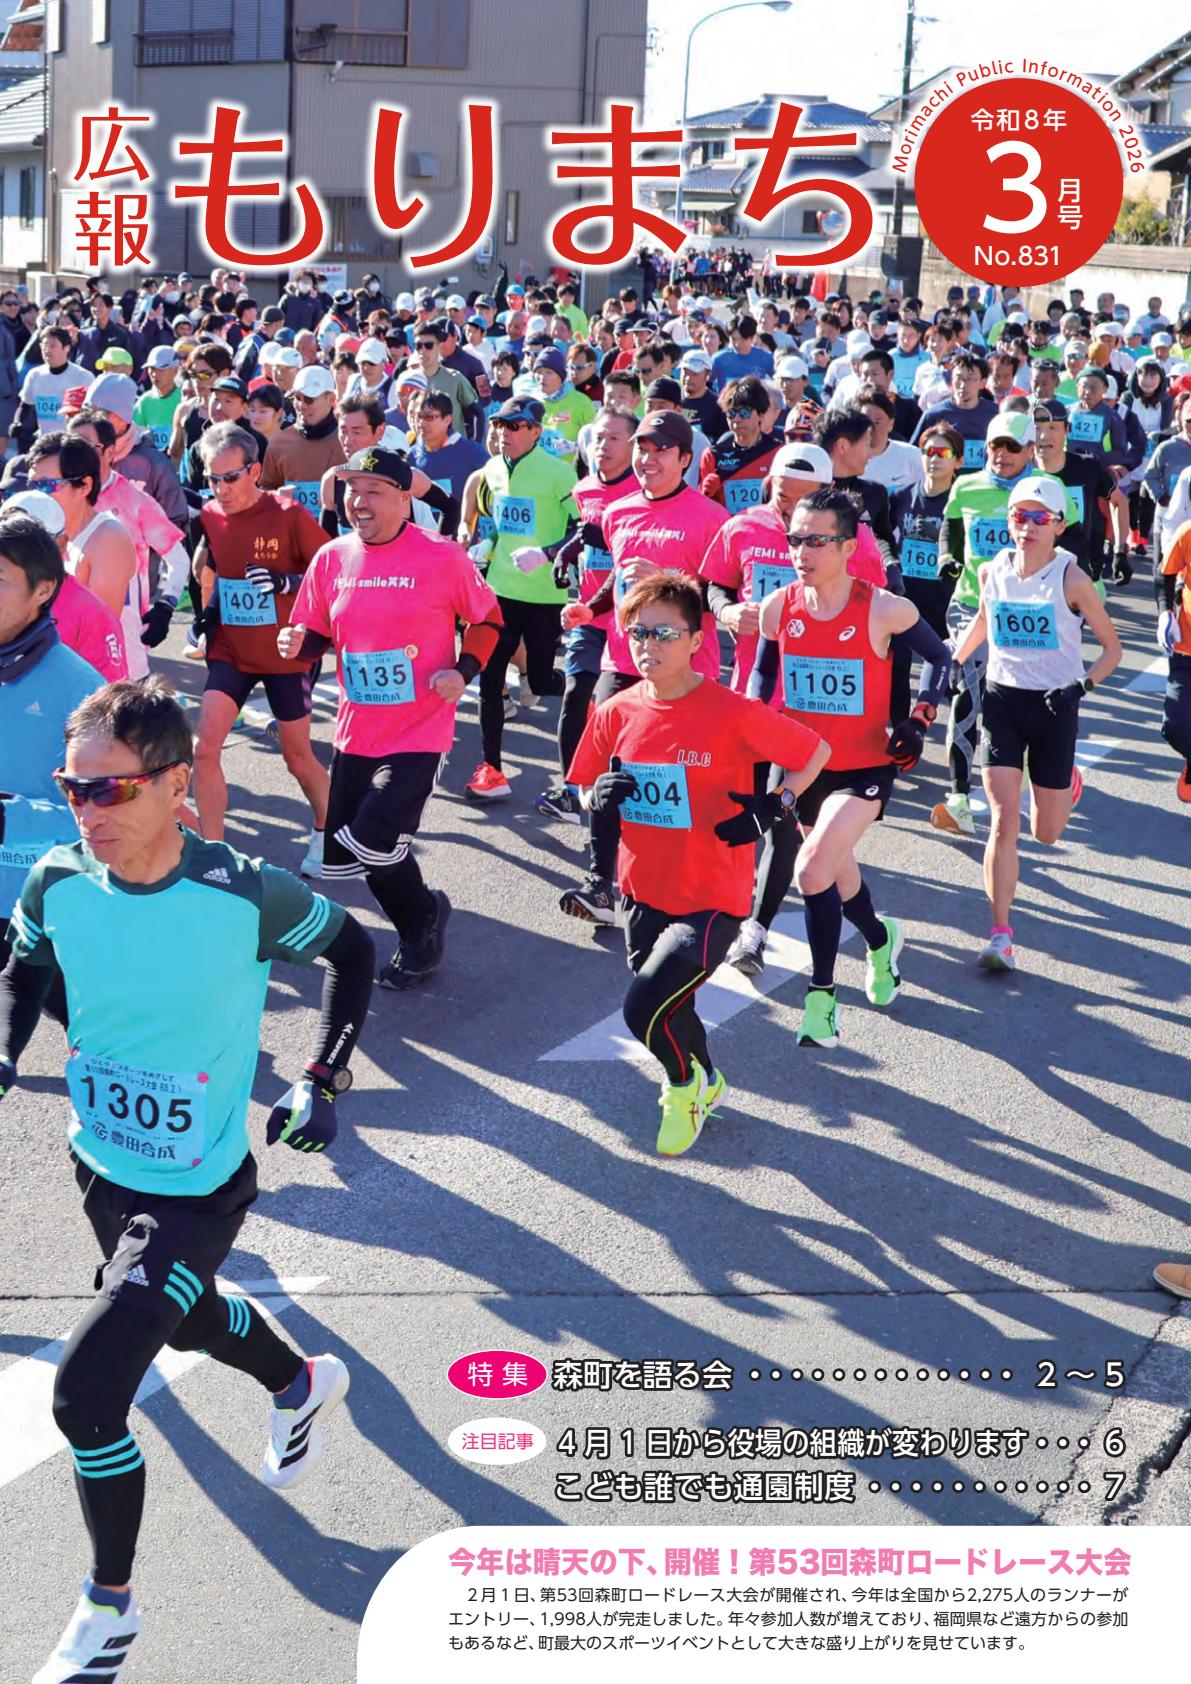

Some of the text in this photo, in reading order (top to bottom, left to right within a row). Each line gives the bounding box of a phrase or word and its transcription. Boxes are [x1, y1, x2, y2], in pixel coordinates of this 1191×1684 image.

[973, 527, 1016, 546] 140
[223, 591, 270, 610] 1402
[995, 613, 1051, 635] 1602
[346, 663, 407, 687] 1135
[789, 669, 857, 696] 1105
[80, 1075, 193, 1133] 1305
